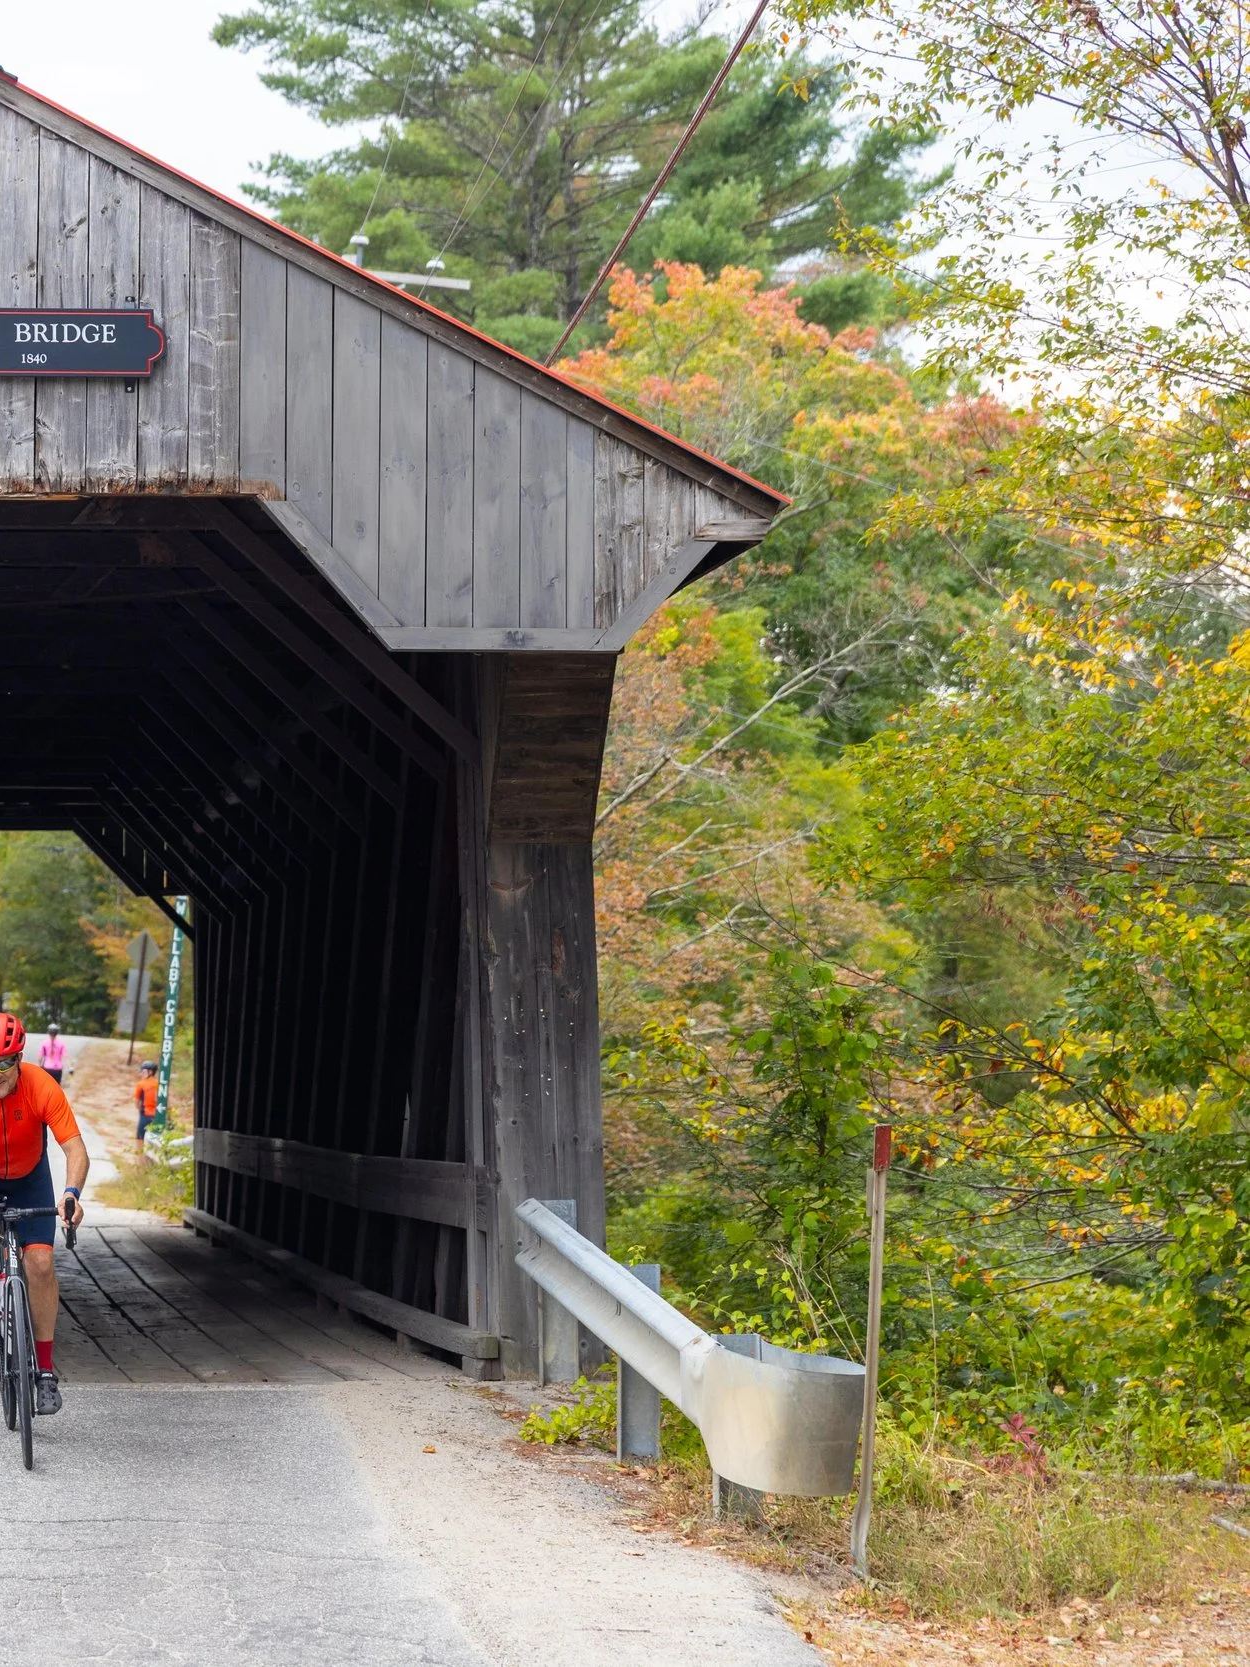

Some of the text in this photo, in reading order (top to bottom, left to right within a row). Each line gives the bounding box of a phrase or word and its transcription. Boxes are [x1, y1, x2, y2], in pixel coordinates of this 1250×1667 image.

[14, 323, 117, 343] BRIDGE
[21, 353, 47, 364] 1840
[158, 900, 186, 1098] WLLABY COLBY LN
